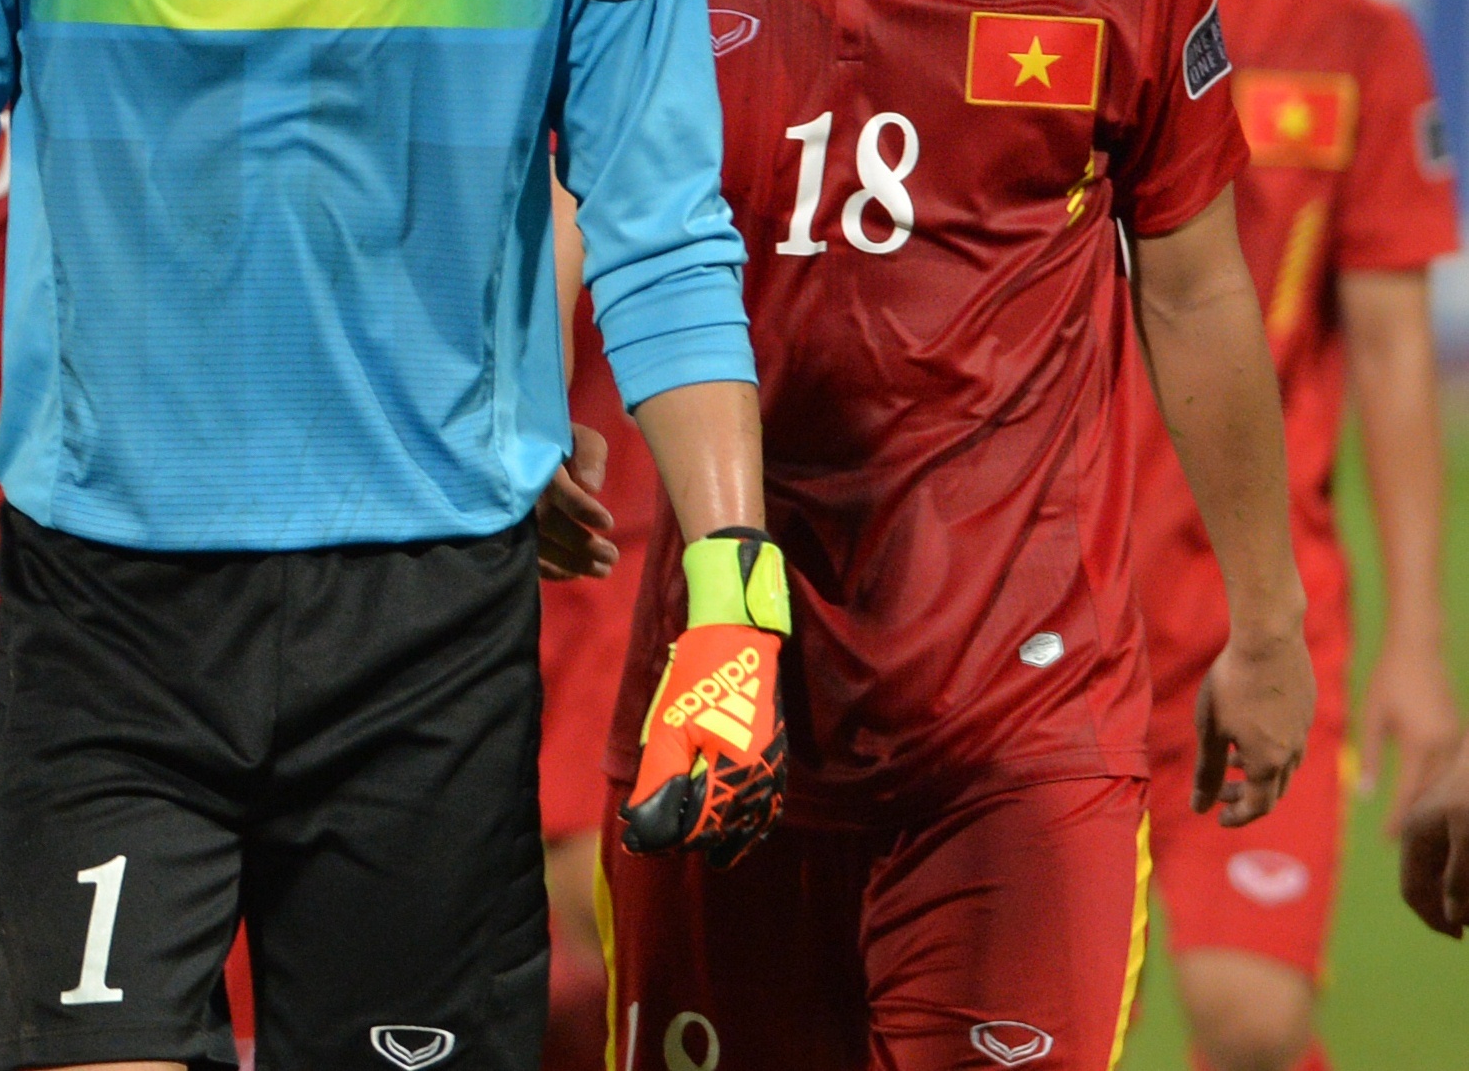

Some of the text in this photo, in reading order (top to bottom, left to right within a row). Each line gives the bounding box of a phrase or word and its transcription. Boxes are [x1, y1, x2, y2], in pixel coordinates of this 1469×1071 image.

[776, 111, 919, 256] 18
[662, 647, 760, 727] adidas
[60, 855, 127, 1005] 1
